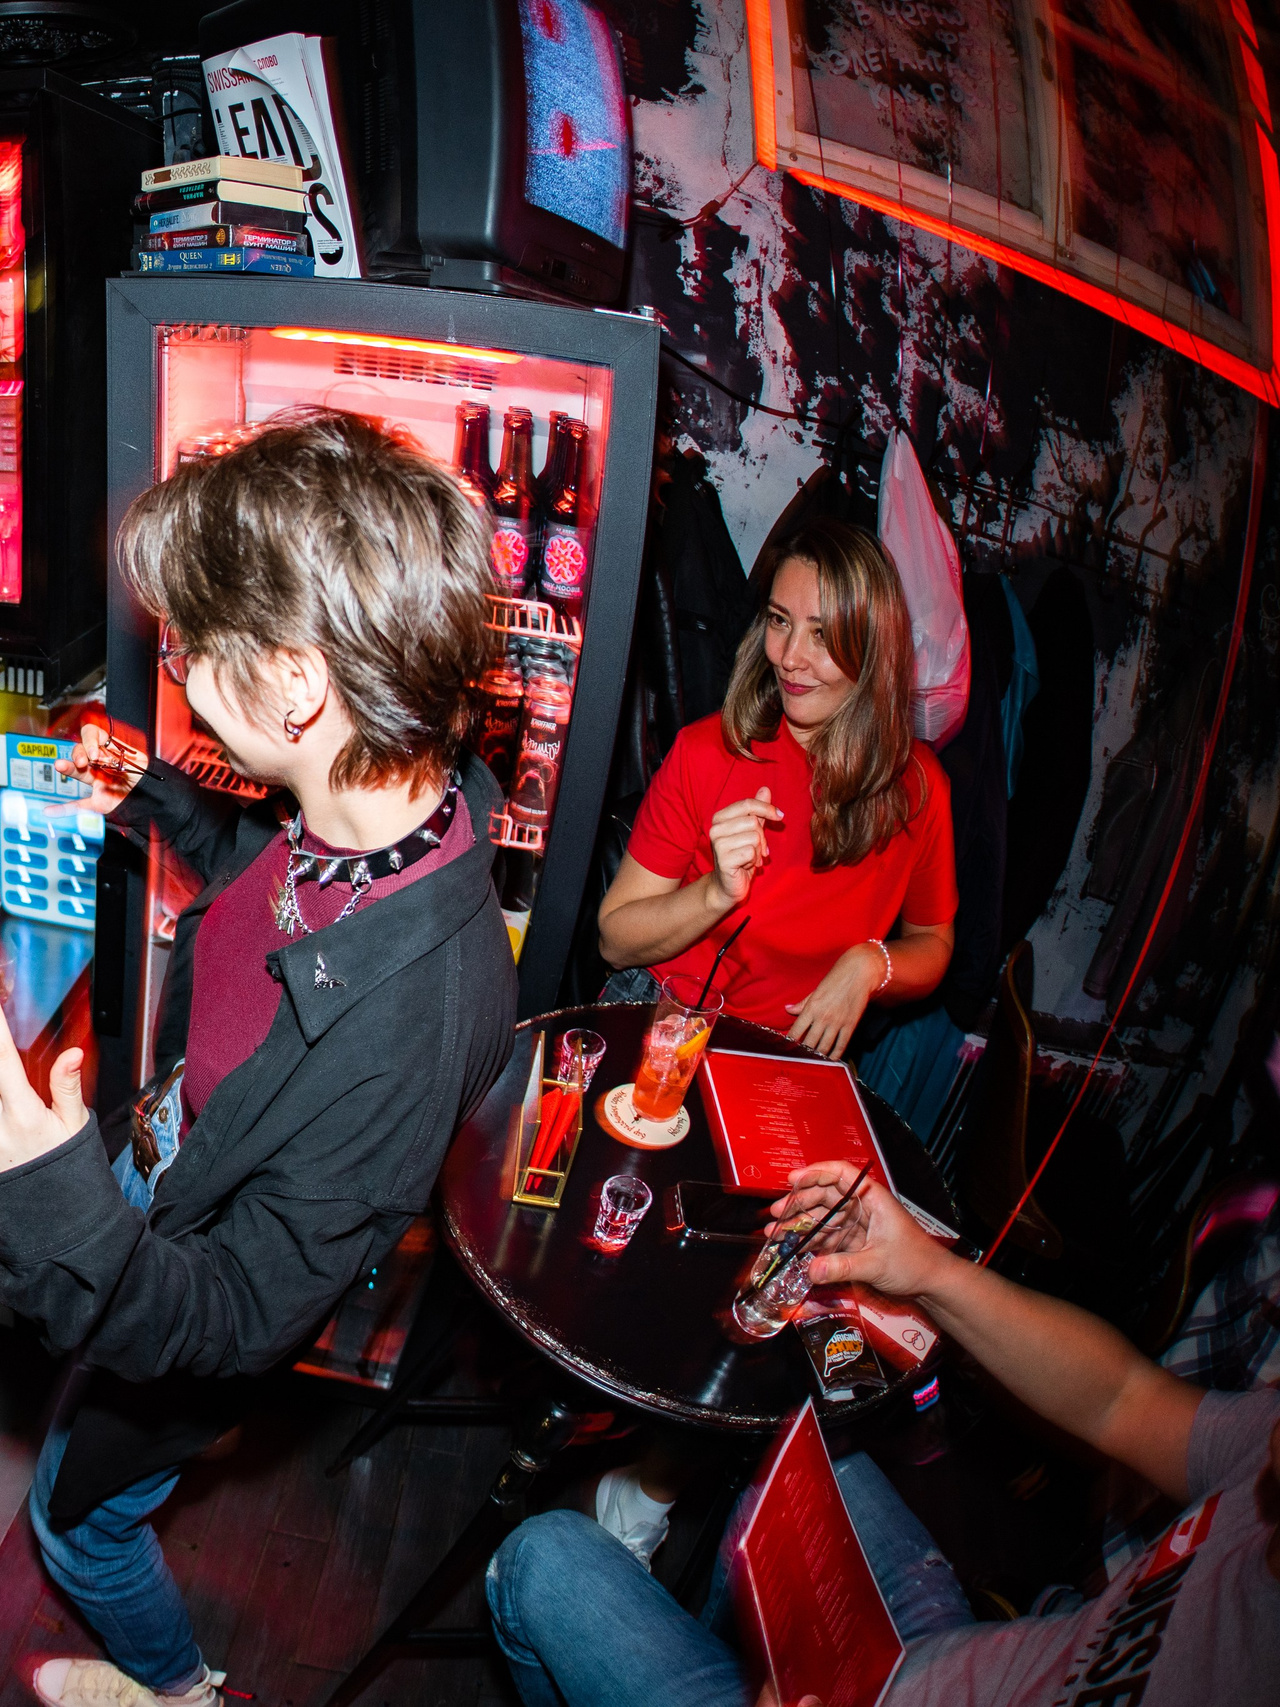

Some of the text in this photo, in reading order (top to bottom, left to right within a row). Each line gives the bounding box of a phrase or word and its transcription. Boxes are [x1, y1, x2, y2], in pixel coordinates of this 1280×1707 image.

[173, 235, 202, 243] ТЕРМИНАТОР
[243, 234, 290, 246] ТЕРМИНАТОР
[243, 241, 297, 252] БУНТ МАШИН
[179, 252, 203, 263] QUEEN
[20, 744, 56, 758] ЗАРЯДИ
[827, 1340, 862, 1357] CHOICE
